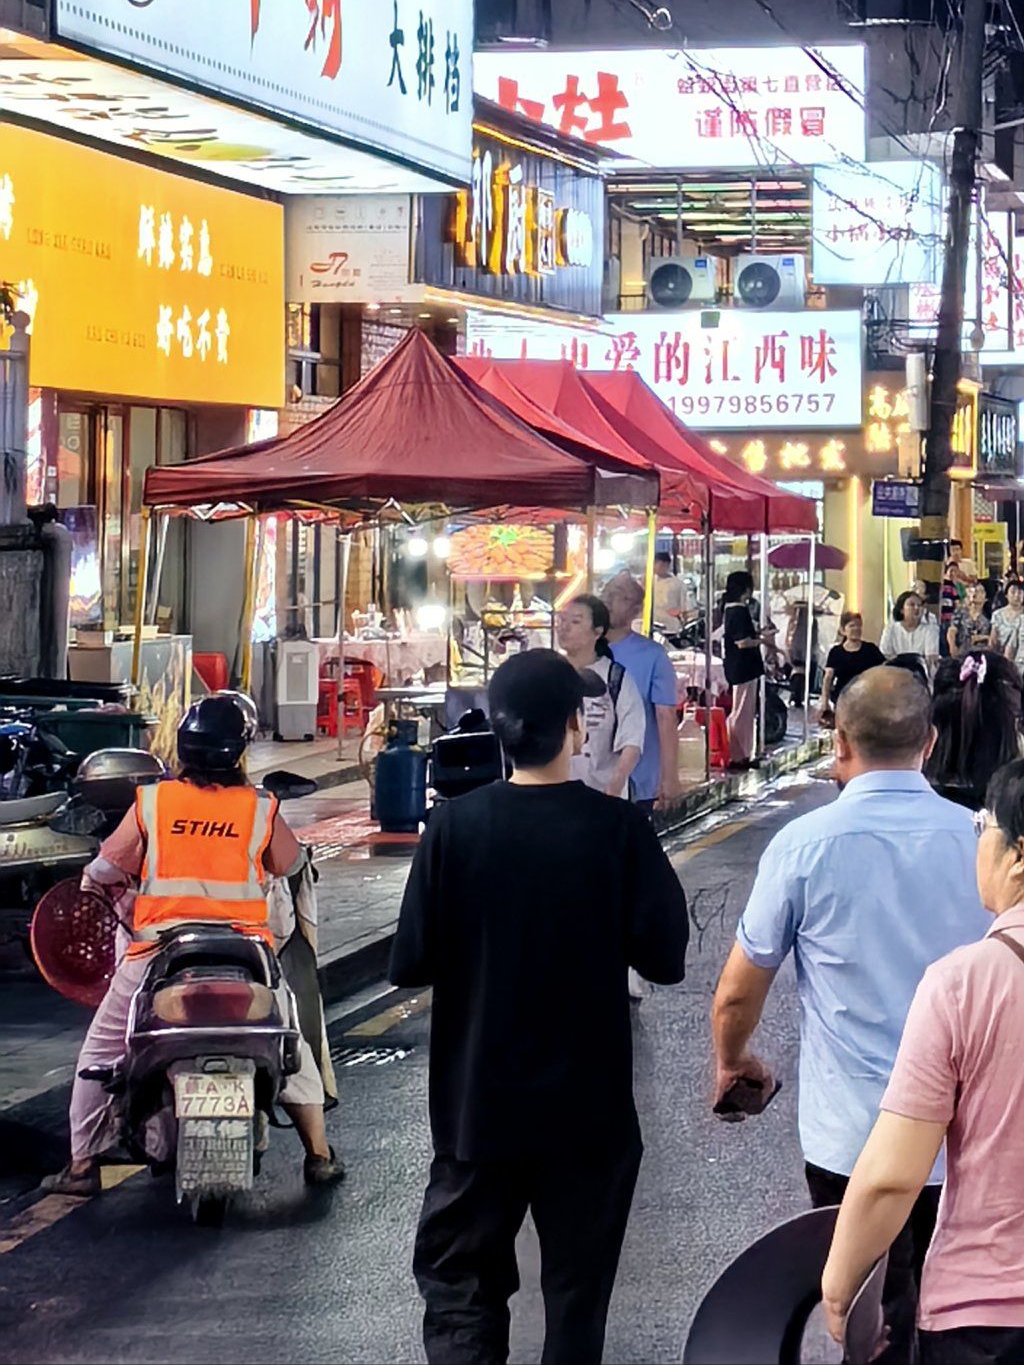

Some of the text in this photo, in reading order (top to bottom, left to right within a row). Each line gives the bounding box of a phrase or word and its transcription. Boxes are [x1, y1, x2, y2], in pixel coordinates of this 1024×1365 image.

[667, 393, 836, 415] 19979856757
[171, 820, 239, 838] STIHL
[181, 1096, 250, 1114] 7773A
